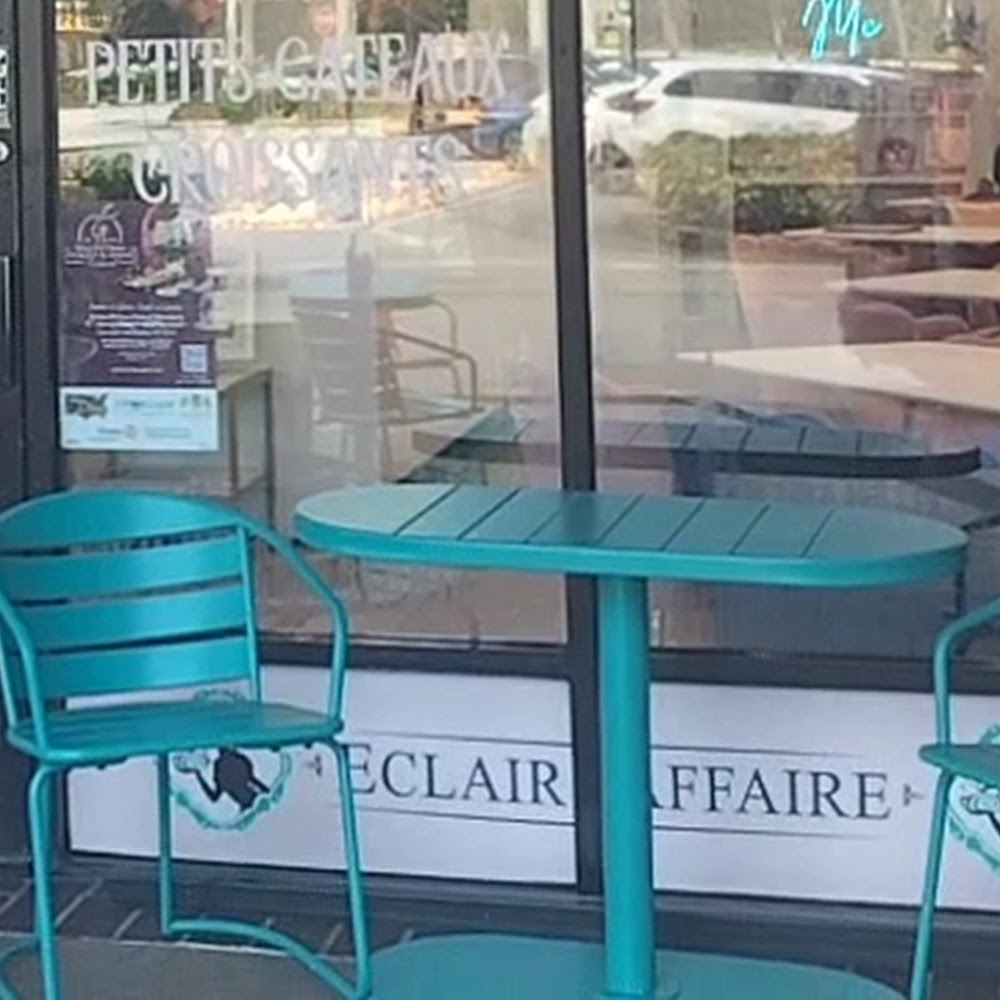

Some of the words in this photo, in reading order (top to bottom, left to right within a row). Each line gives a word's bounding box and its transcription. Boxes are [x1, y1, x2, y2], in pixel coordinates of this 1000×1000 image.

[86, 34, 254, 104] PETITS
[342, 743, 567, 807] ECLAIR
[649, 763, 891, 820] FFAIRE
